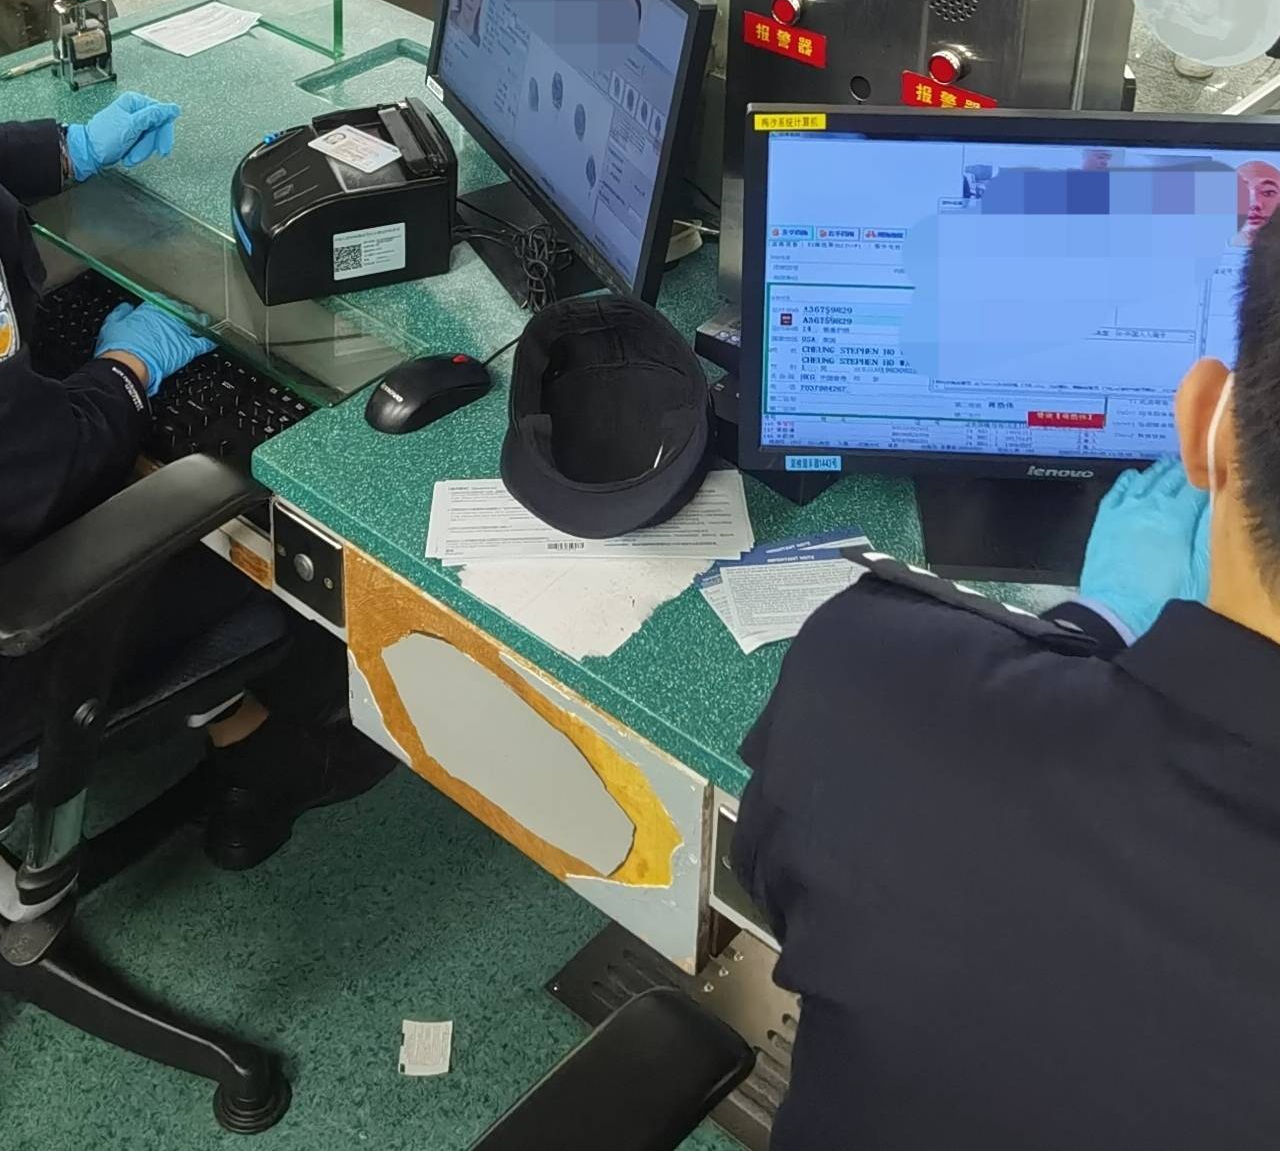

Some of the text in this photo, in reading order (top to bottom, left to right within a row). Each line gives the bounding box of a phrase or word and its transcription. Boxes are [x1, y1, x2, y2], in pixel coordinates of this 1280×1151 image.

[756, 22, 813, 57] 报警器
[1026, 465, 1094, 479] lenovo
